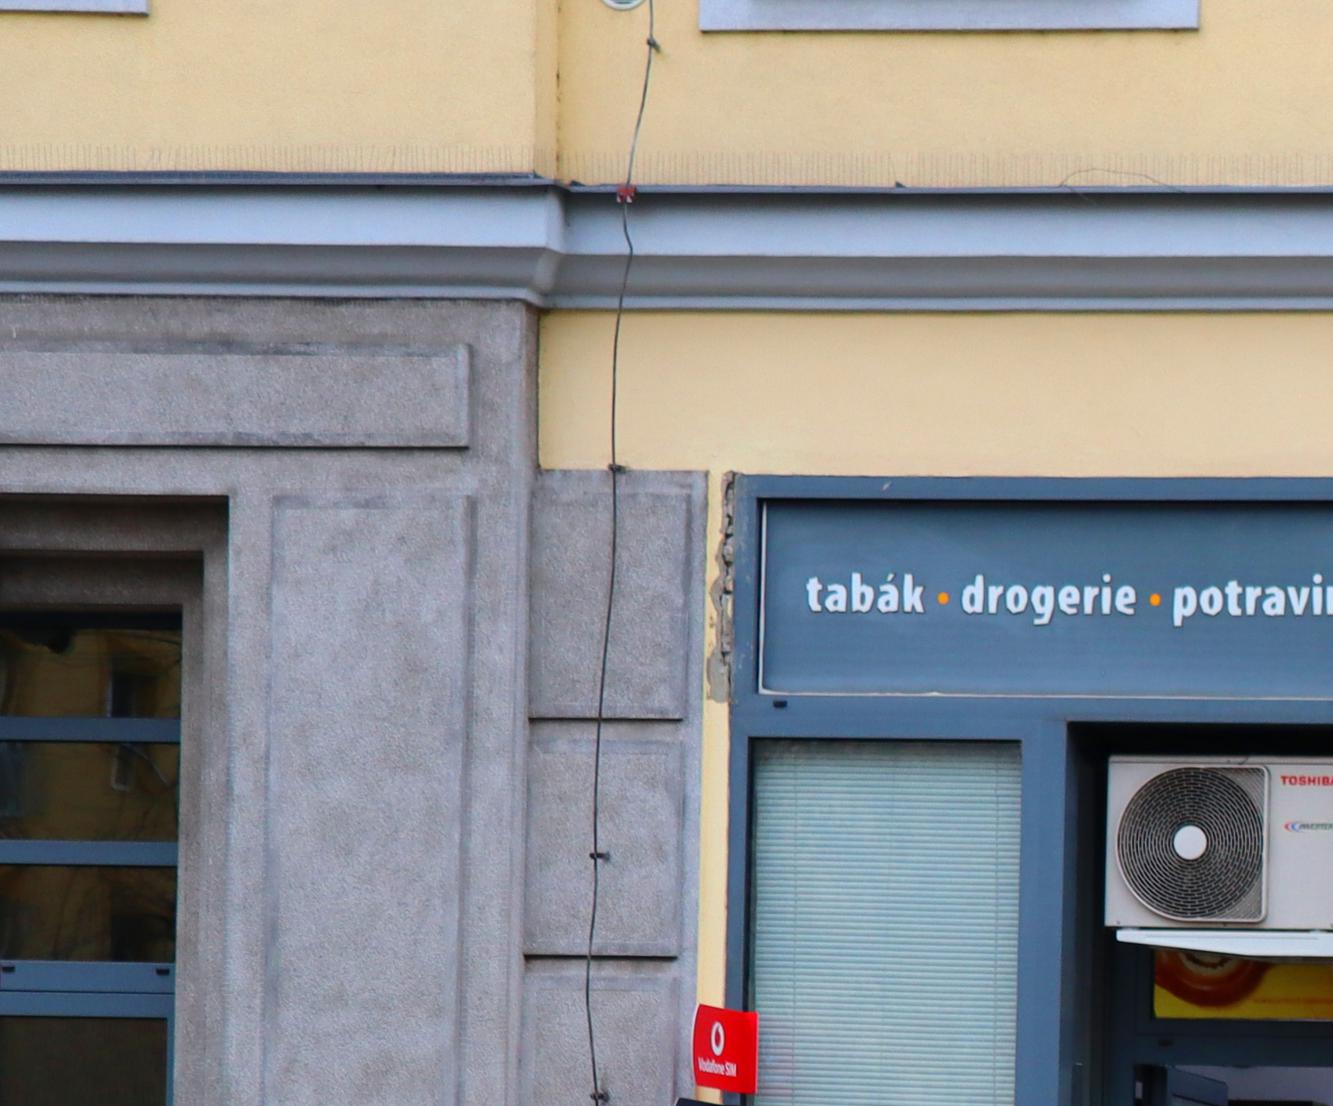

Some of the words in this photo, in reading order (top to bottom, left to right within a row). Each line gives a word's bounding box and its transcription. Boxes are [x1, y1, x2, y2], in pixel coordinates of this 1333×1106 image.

[806, 572, 925, 613] tabák
[961, 574, 1137, 625] drogerie
[697, 1056, 726, 1076] Vodafone
[724, 1061, 737, 1077] SIM
